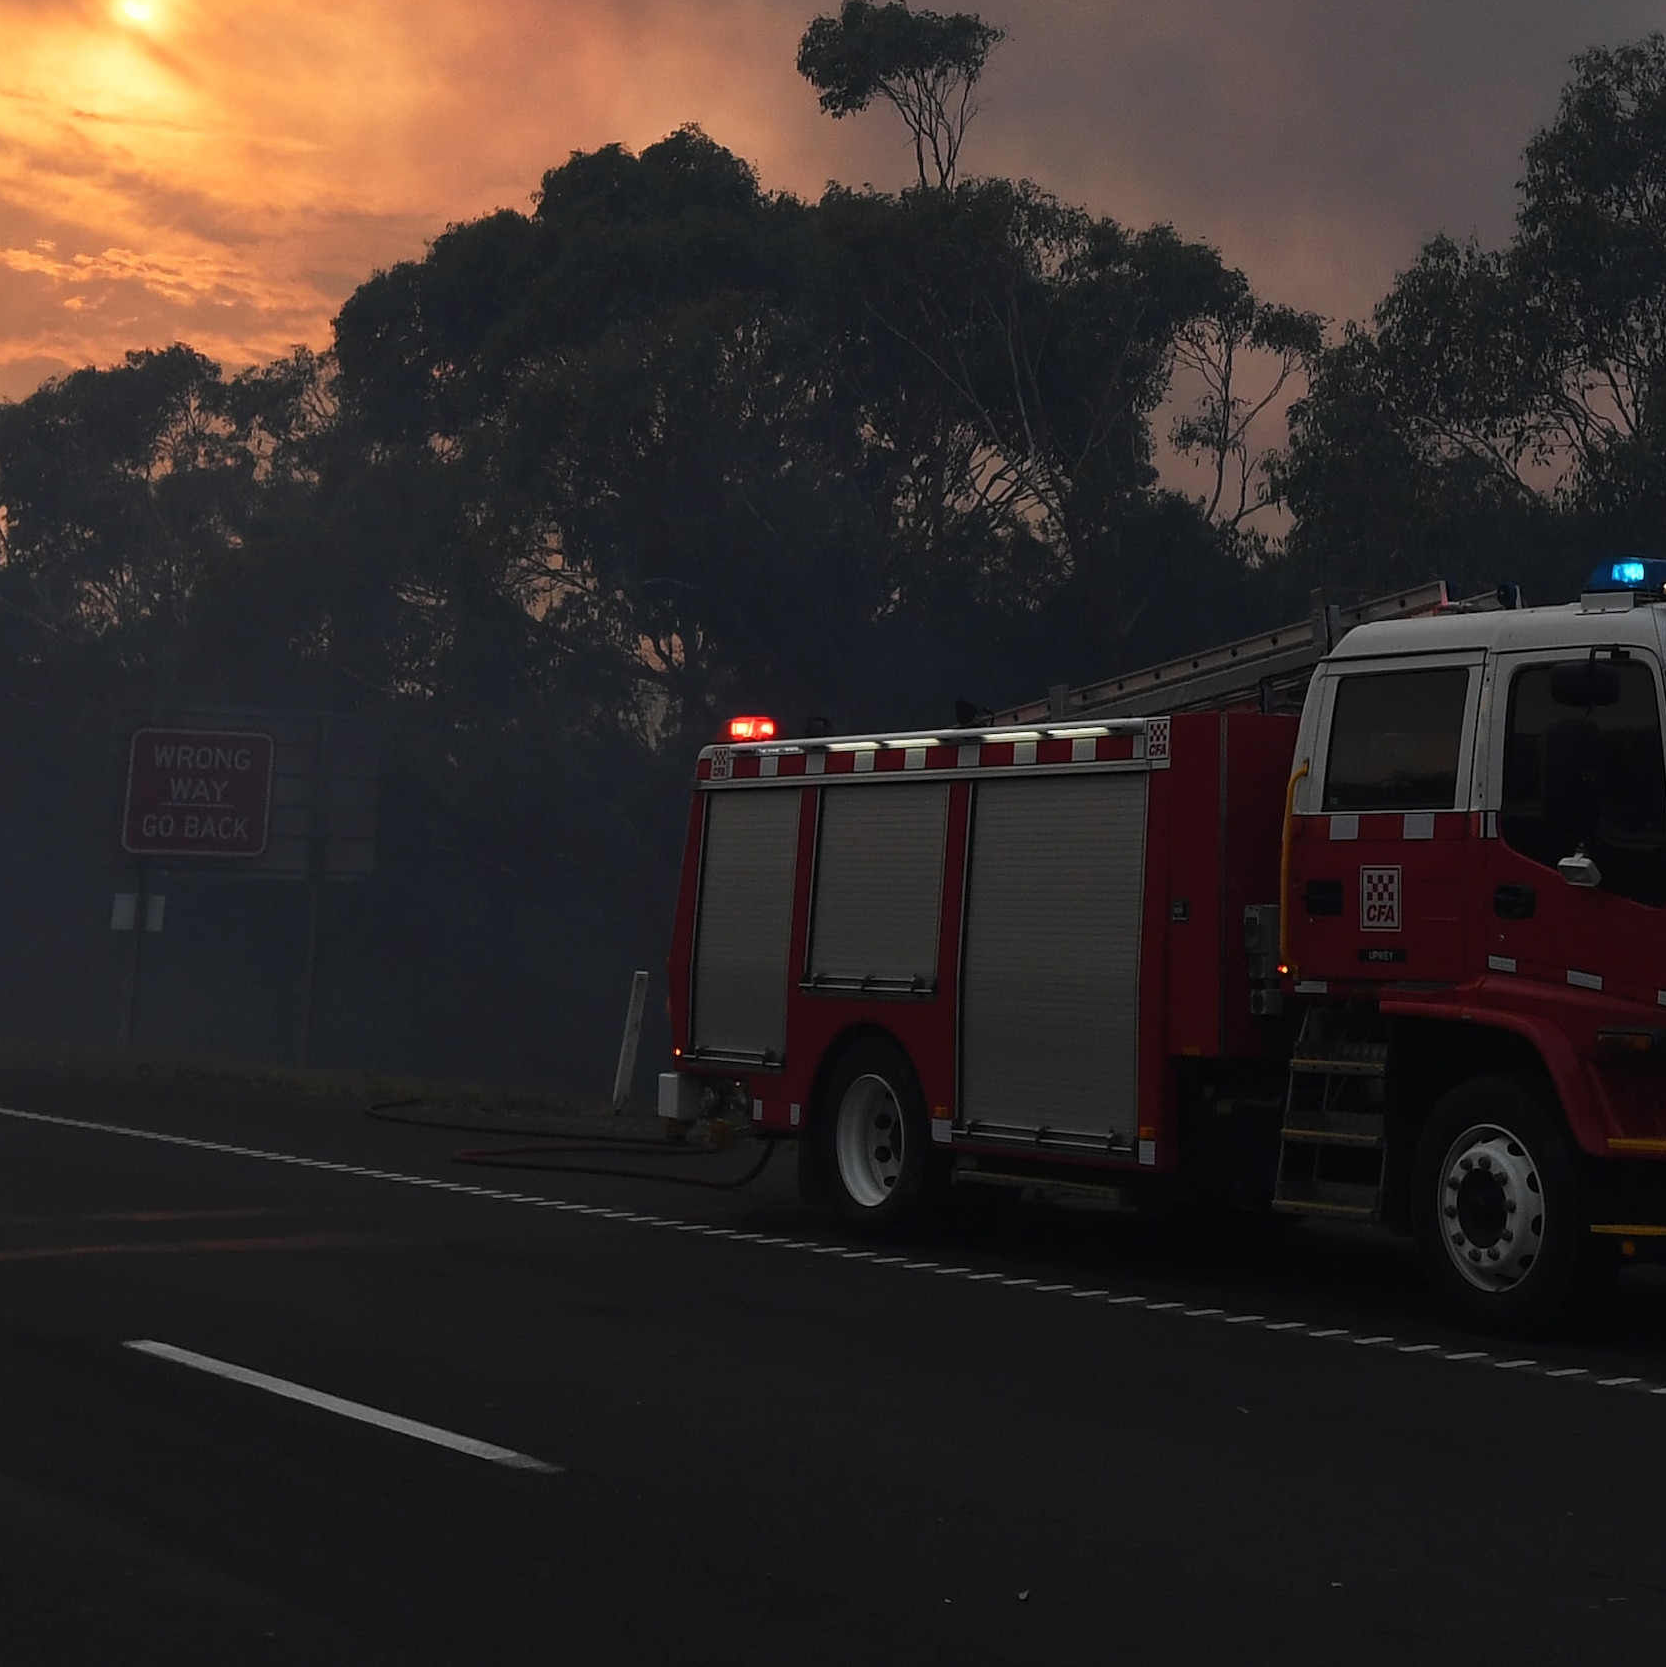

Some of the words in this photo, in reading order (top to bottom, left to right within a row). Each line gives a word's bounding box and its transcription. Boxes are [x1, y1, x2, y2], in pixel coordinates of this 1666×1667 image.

[154, 745, 251, 771] WRONG
[1149, 743, 1167, 756] CFA
[170, 777, 229, 803] WAY
[142, 814, 174, 838] GO
[184, 815, 248, 840] BACK
[1366, 904, 1395, 922] CFA
